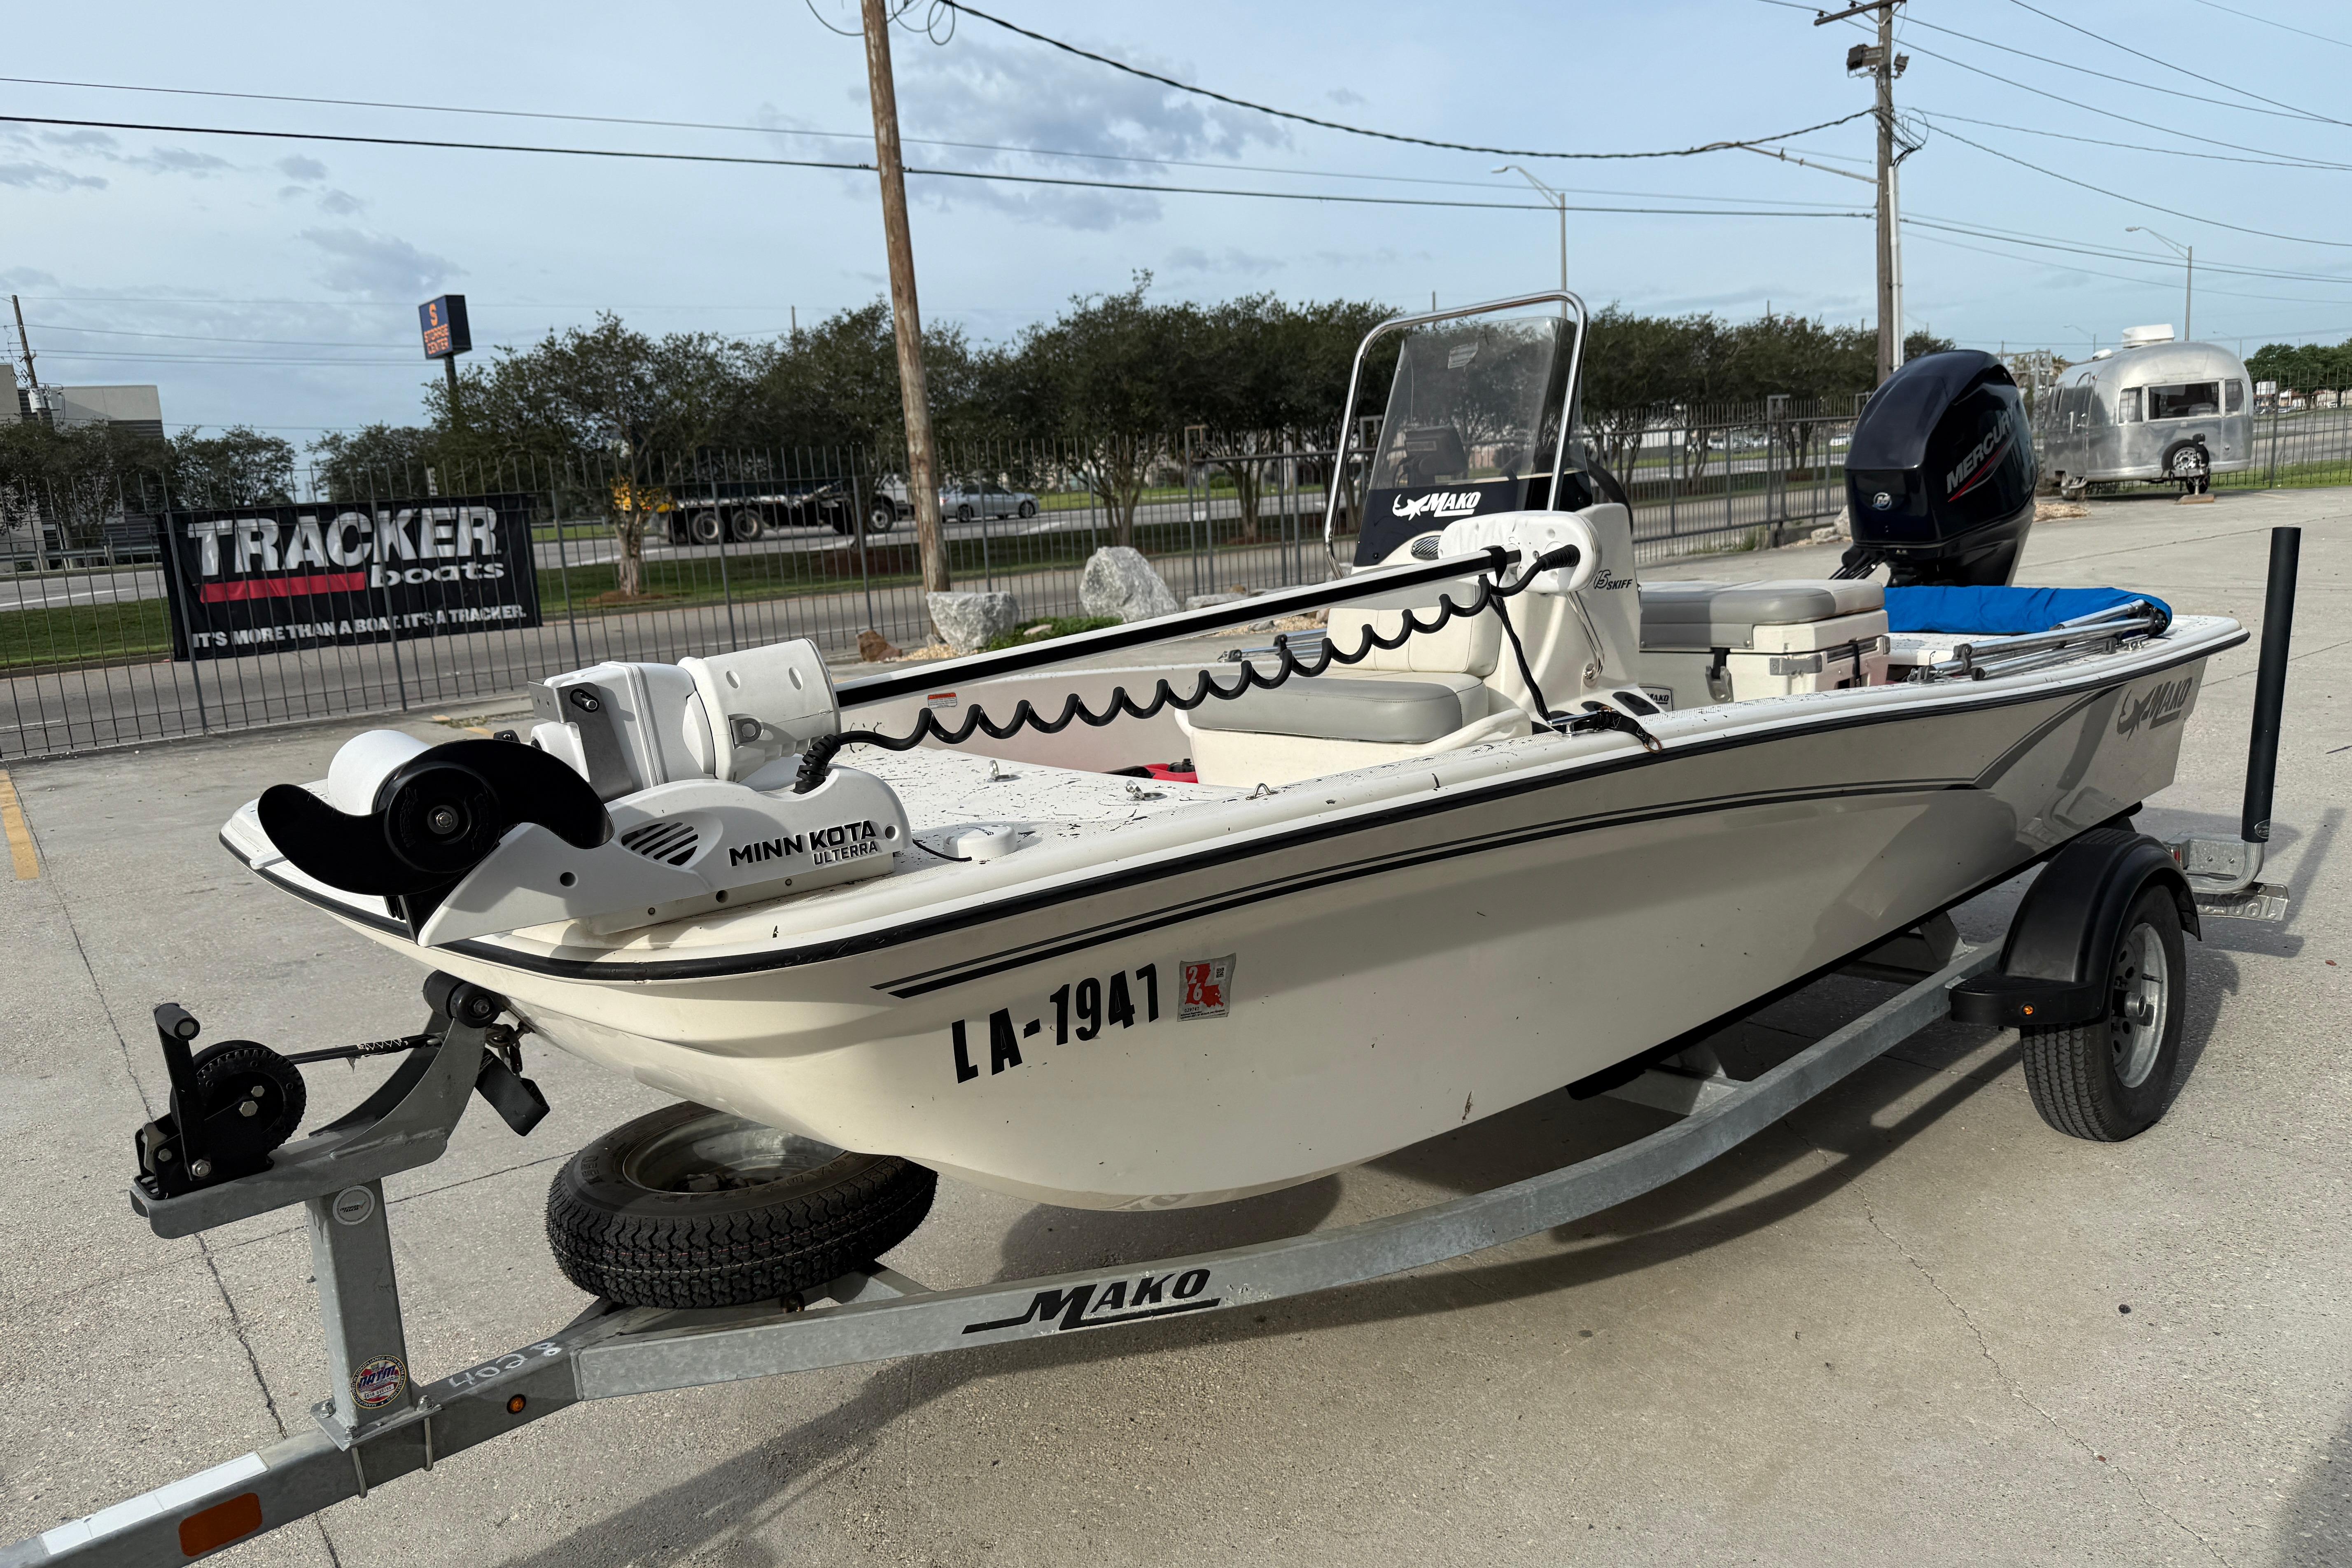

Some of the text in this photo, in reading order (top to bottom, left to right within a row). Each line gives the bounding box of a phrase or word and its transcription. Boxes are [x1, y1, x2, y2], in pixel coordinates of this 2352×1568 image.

[1946, 401, 2013, 494] MERCURY
[1421, 492, 1482, 517] MAKO
[187, 506, 497, 576] TRACKER
[371, 562, 504, 588] boats
[1606, 579, 1633, 590] SKIFF
[192, 631, 228, 648] IT'S
[232, 627, 285, 646] MORE
[285, 620, 336, 639] THAN
[339, 620, 352, 635] A
[403, 611, 435, 629] IT'S
[436, 610, 446, 624] A
[2142, 677, 2193, 730] MAKO
[728, 820, 877, 867] MINN KOTA
[813, 840, 878, 866] ULTERRA
[999, 1269, 1216, 1331] MAKO
